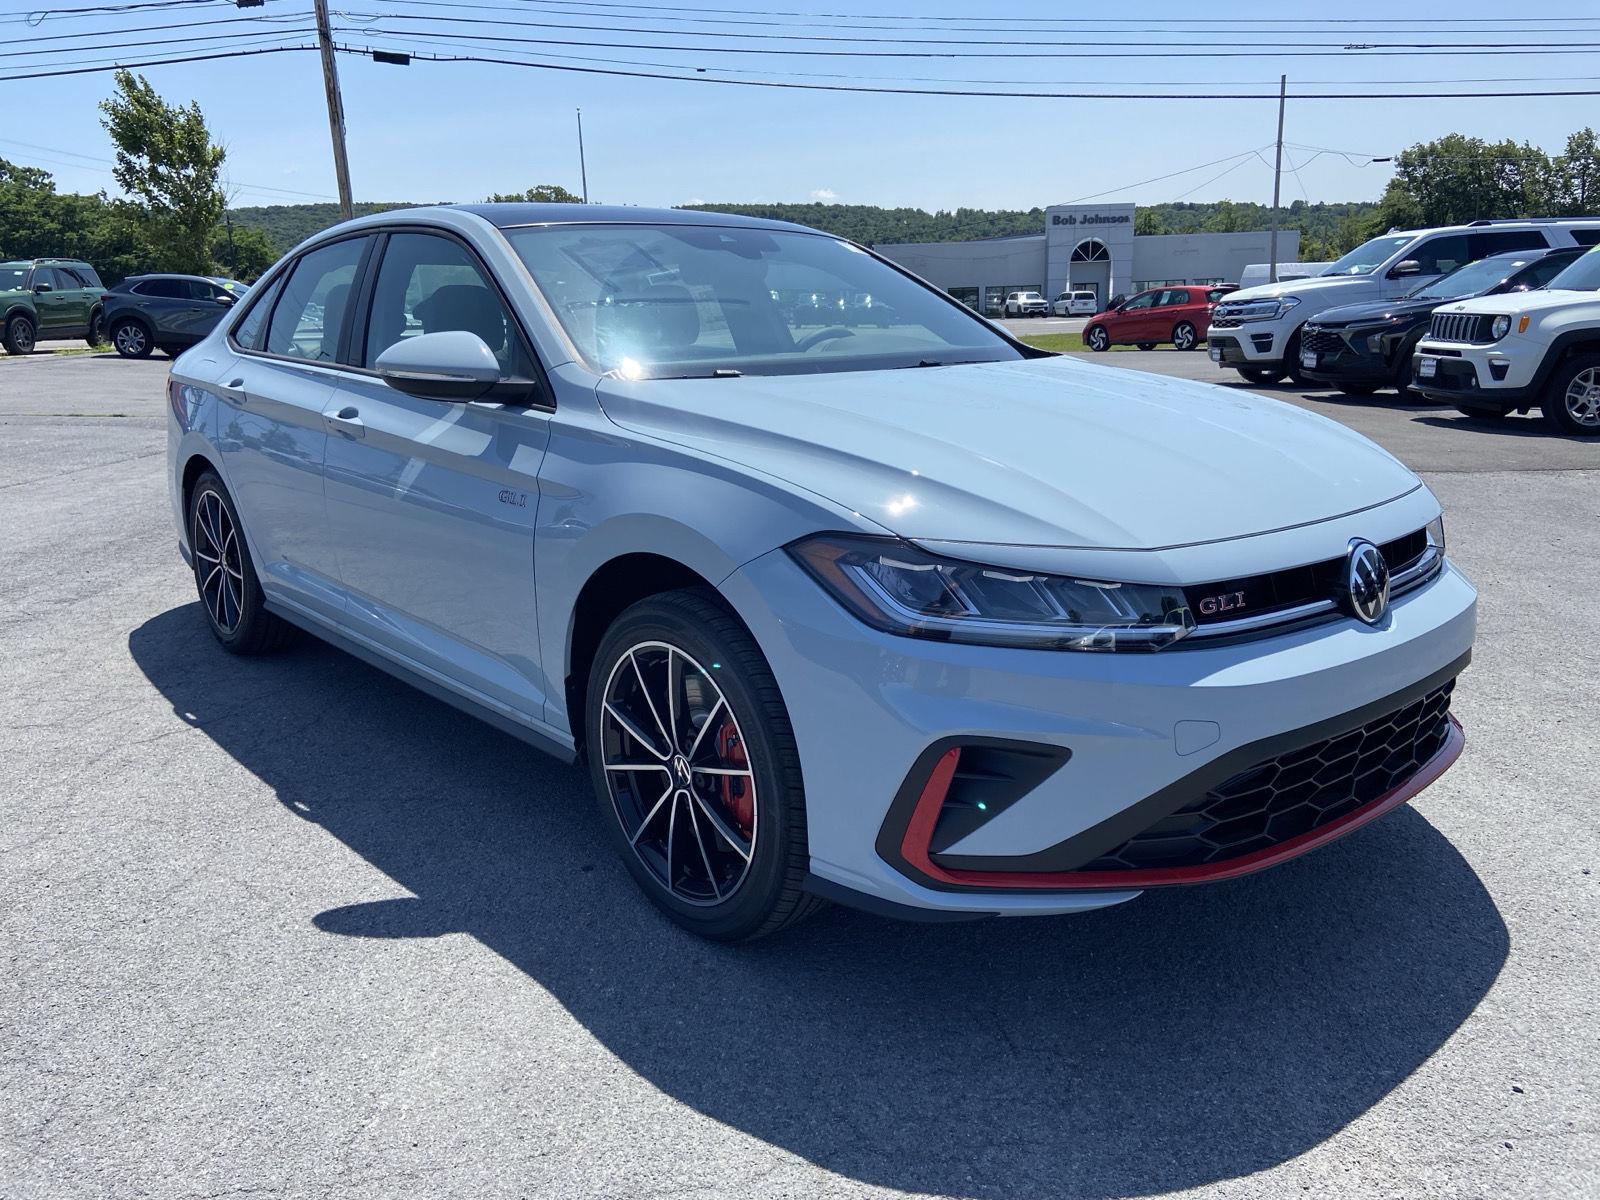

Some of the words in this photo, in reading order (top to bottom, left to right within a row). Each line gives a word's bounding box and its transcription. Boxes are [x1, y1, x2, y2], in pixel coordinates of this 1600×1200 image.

[1052, 215, 1077, 225] Bob
[1079, 214, 1130, 225] Johnson
[498, 490, 526, 508] GLI
[1199, 591, 1246, 614] GLI
